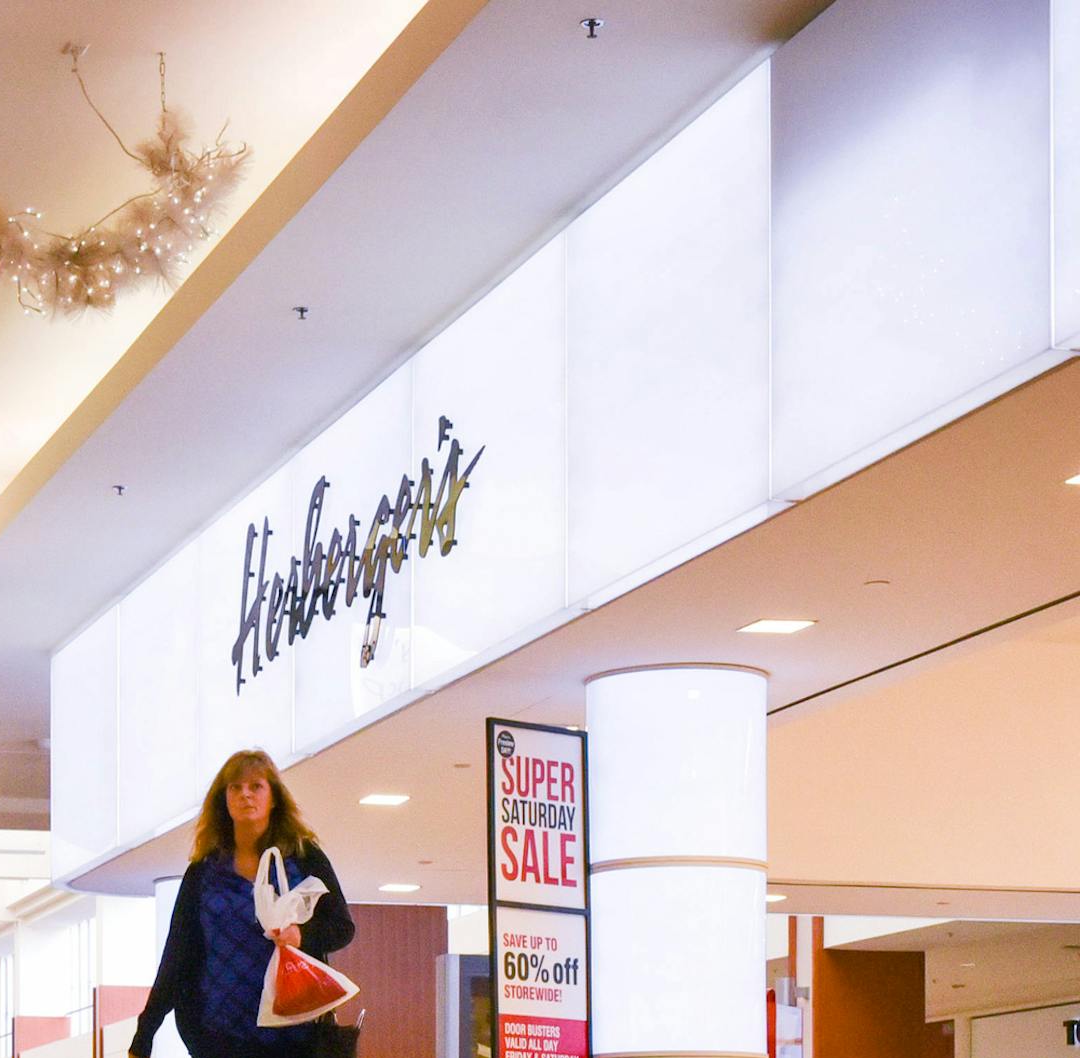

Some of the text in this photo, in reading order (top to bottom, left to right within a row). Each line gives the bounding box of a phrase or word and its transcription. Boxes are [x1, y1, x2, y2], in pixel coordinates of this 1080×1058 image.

[501, 755, 576, 803] SUPER
[501, 797, 576, 831] SATURDAY
[500, 826, 577, 888] SALE
[503, 933, 558, 952] SAVE UP TO
[504, 951, 579, 985] 60% off
[504, 985, 562, 1003] STOREWIDE!
[504, 1023, 560, 1038] DOOR BUSTERS
[505, 1037, 559, 1053] VALID ALL DAY
